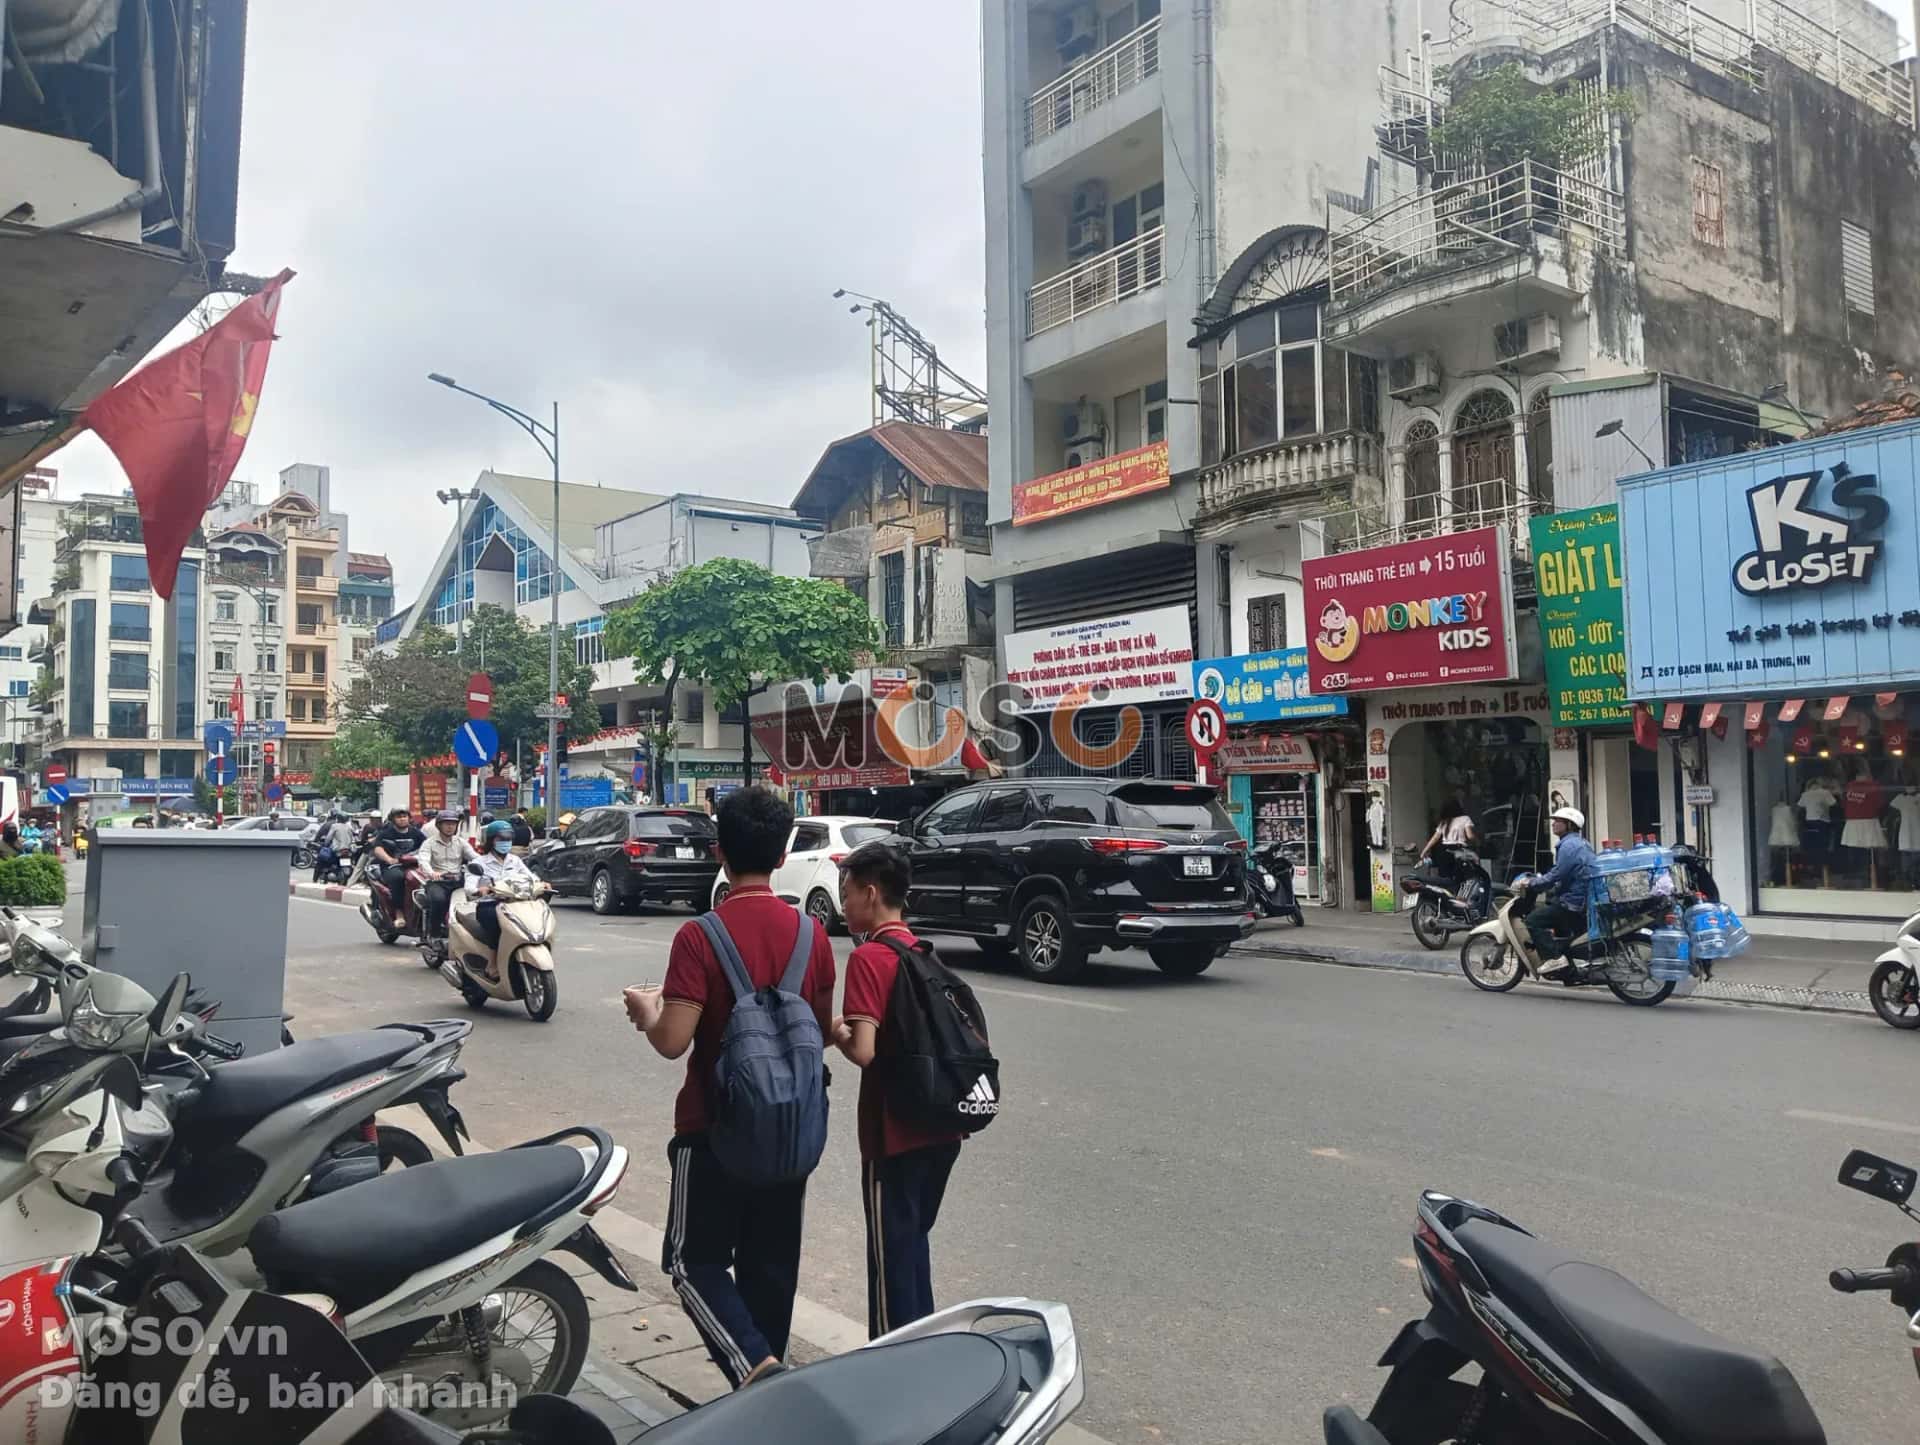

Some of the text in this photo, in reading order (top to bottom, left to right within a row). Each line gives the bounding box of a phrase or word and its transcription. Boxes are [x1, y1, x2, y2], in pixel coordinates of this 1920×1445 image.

[1314, 545, 1486, 591] THỜI TRANG TRẺ EM 15 TUỔI
[1538, 538, 1597, 604] GIẶT
[1362, 591, 1488, 635] MONKEY
[1438, 626, 1492, 652] KIDS
[1569, 651, 1597, 678] CÁC
[1658, 666, 1675, 678] 267
[1678, 664, 1702, 679] BẠCH
[1727, 660, 1744, 673] HAI
[1745, 658, 1759, 671] BÀ
[1796, 654, 1812, 667] HN
[1326, 674, 1346, 686] 265
[1503, 691, 1520, 713] 15
[1578, 687, 1604, 705] 0936
[1579, 708, 1598, 721] 267
[957, 1100, 1000, 1115] adidas
